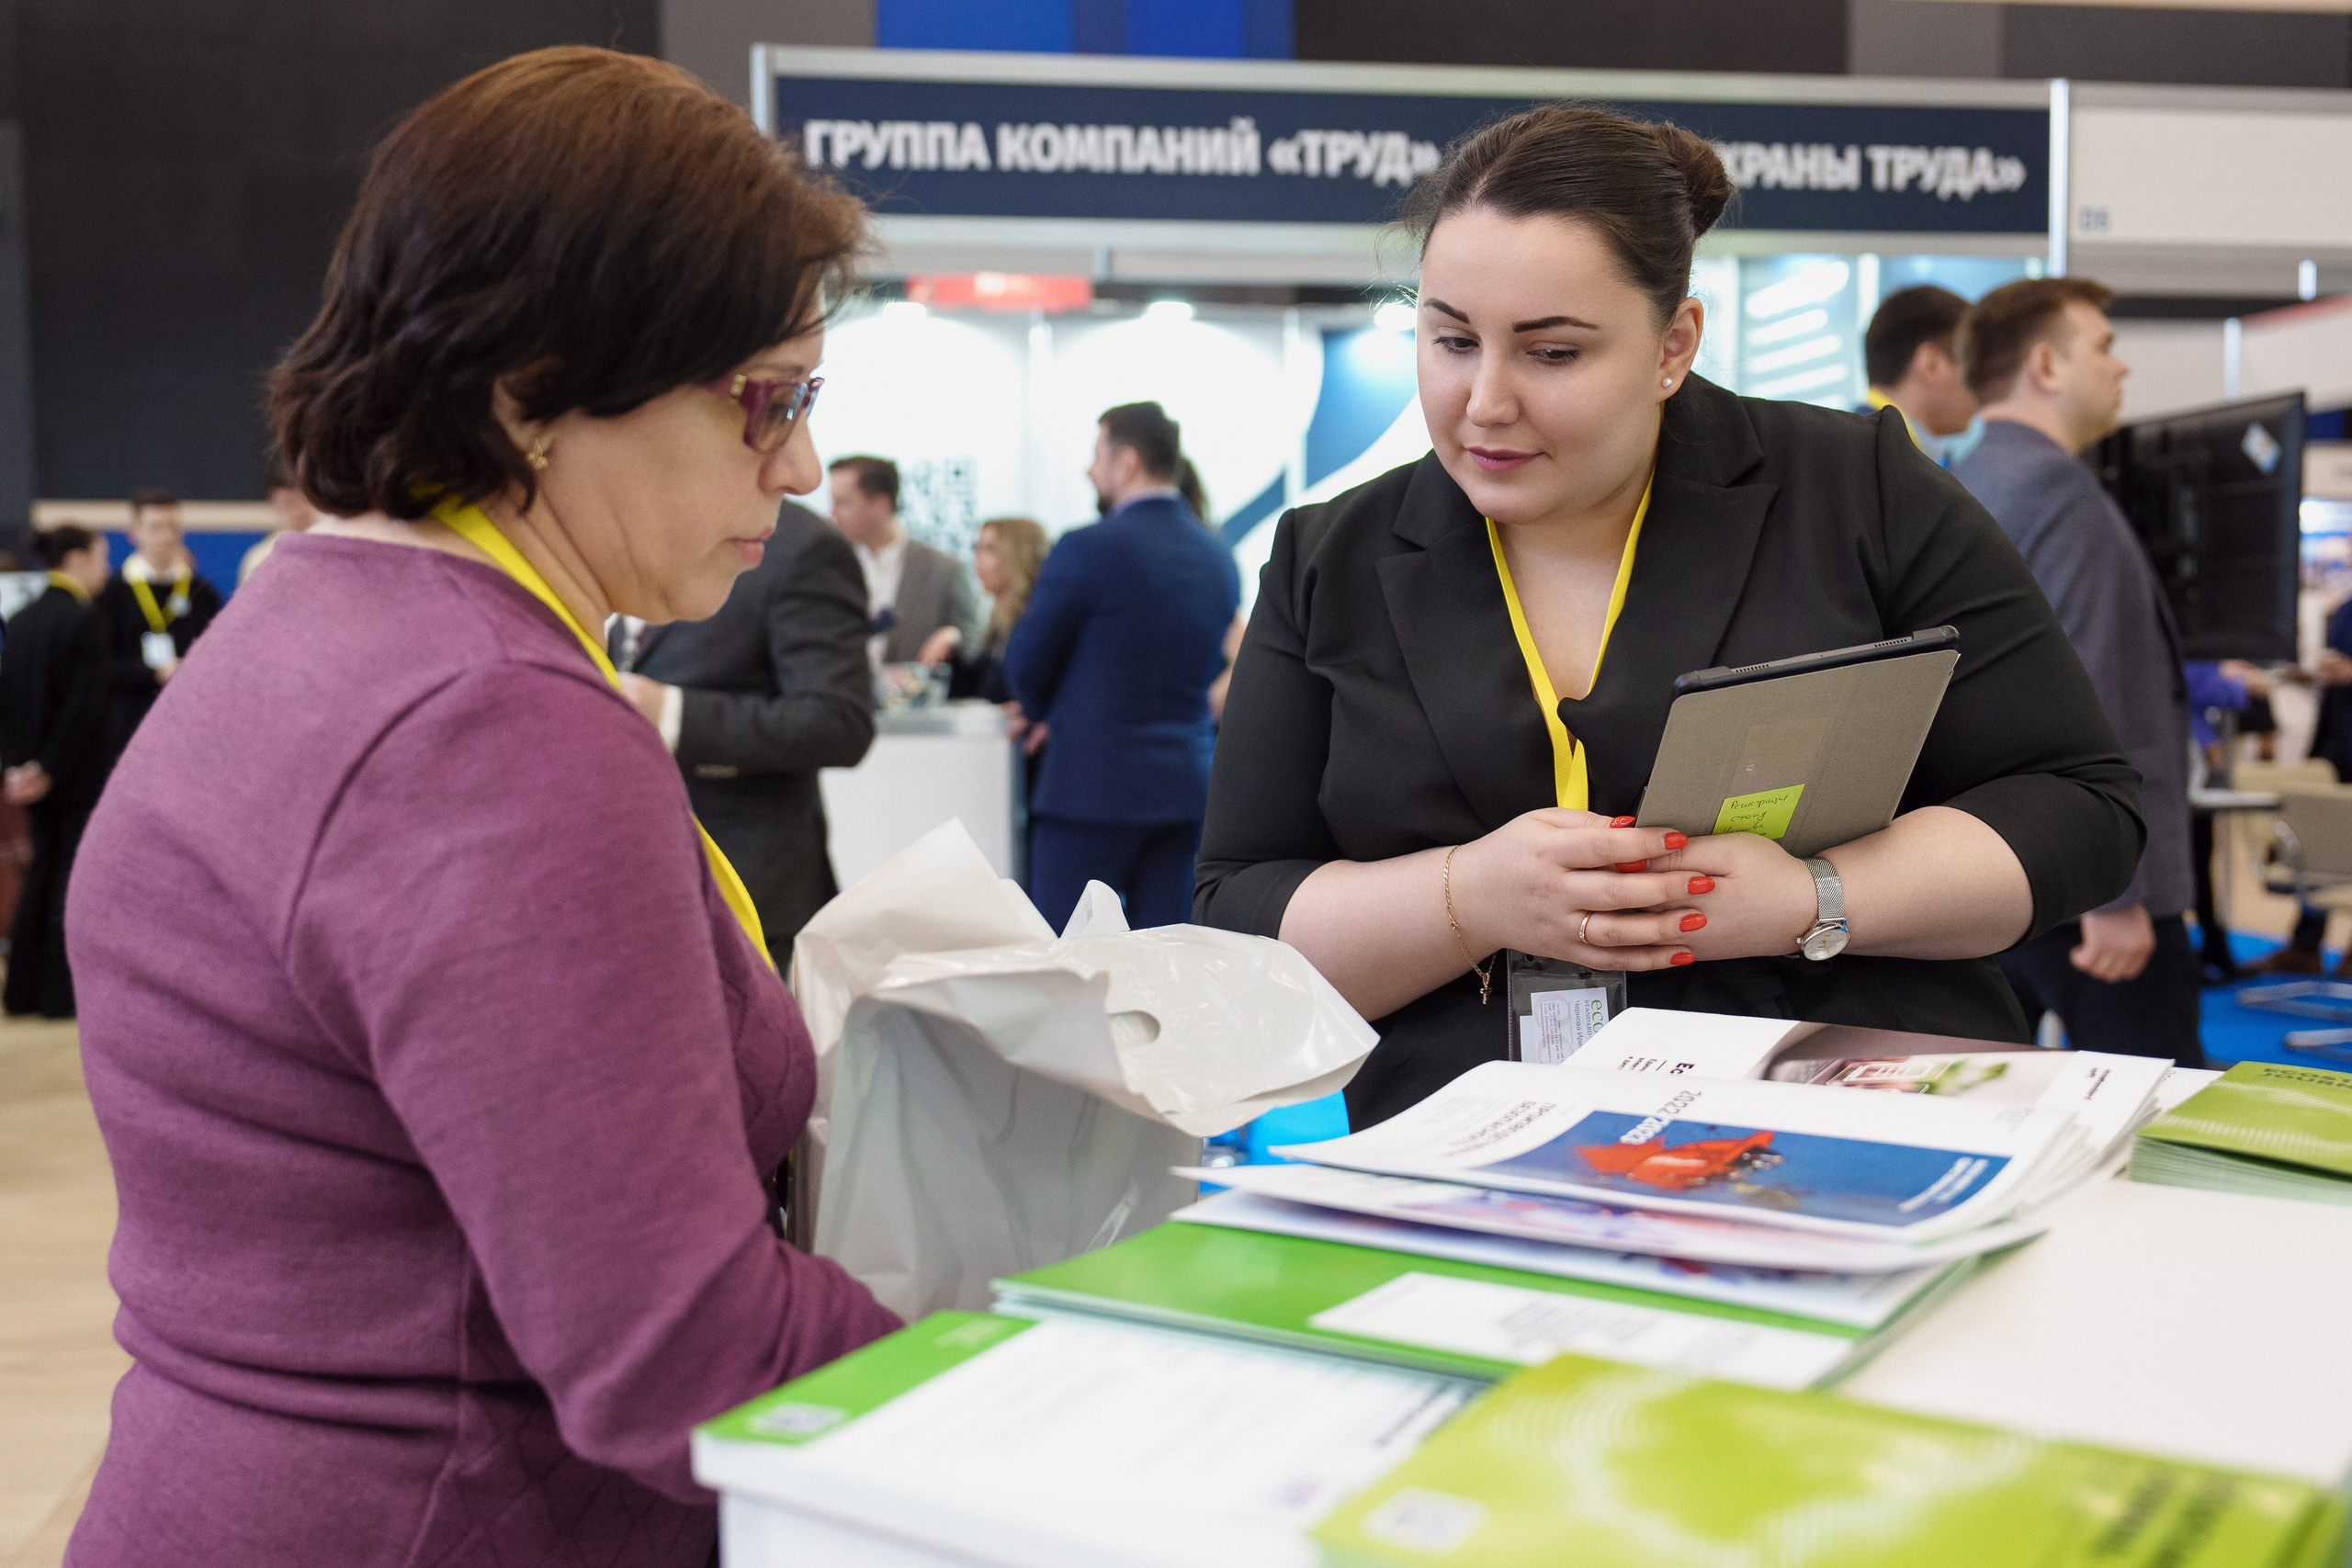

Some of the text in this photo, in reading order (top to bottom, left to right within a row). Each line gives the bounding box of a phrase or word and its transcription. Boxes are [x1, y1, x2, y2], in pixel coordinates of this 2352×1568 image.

[804, 119, 990, 171] ГРУППА
[996, 117, 1261, 175] КОМПАНИЙ
[1268, 130, 1442, 186] «ТРУД»
[1866, 143, 2026, 200] ТРУДА»
[1584, 999, 1592, 1036] STANDARD
